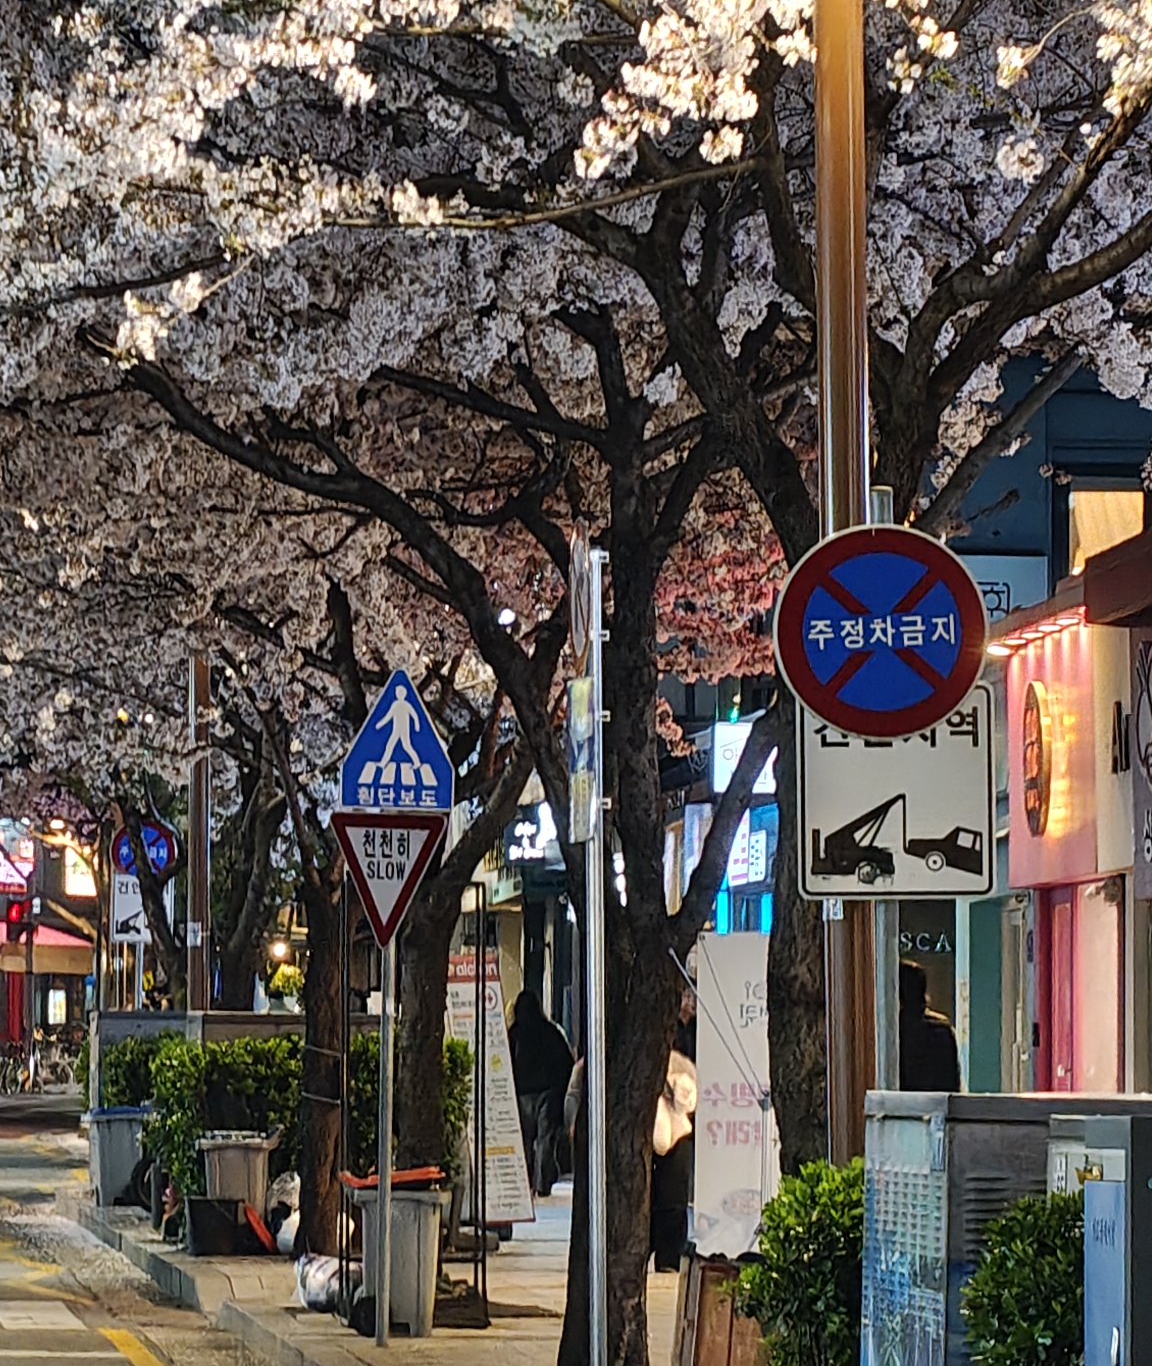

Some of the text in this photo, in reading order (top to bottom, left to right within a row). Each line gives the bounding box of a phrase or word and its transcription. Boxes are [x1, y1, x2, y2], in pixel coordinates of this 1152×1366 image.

[808, 612, 957, 651] 주정차금지
[358, 786, 438, 806] 횡단보도
[362, 828, 411, 862] 천천히
[367, 860, 407, 882] SLOW
